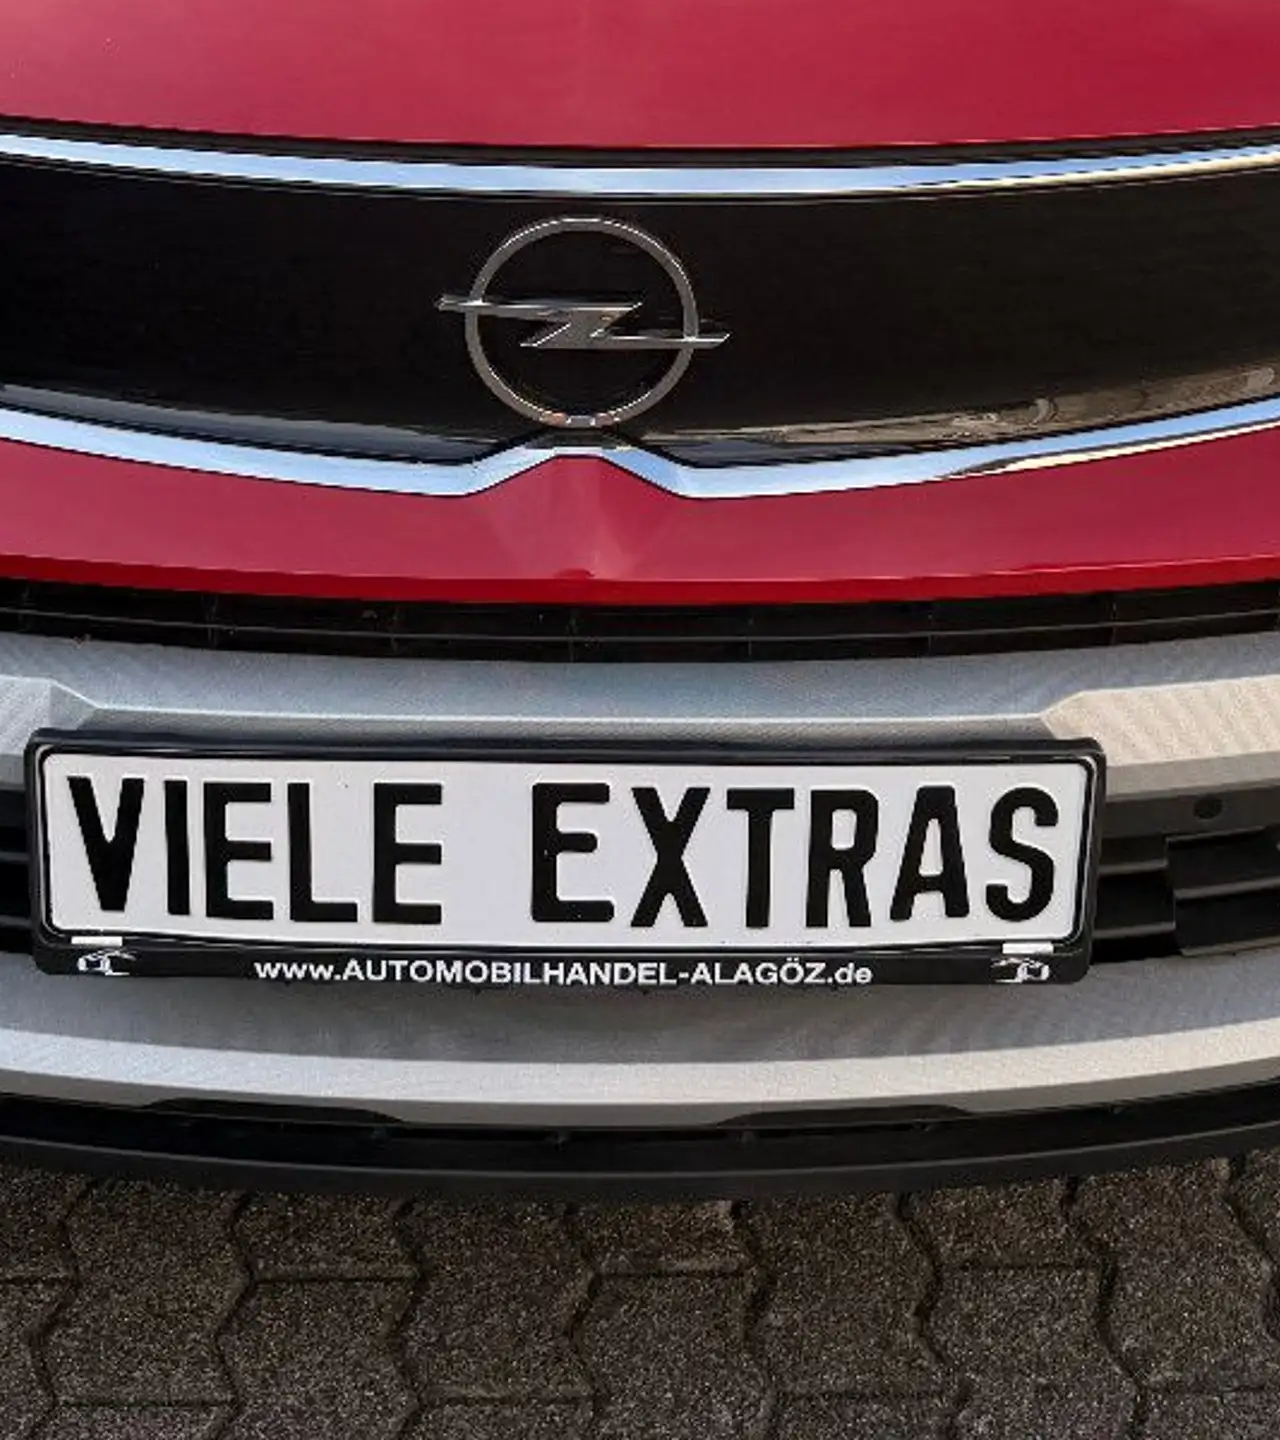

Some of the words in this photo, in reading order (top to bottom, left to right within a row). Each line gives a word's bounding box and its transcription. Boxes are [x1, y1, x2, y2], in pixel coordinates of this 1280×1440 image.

[67, 775, 443, 925] VIELE
[531, 782, 1059, 928] EXTRAS
[253, 956, 872, 985] www.AUTOMOBILHANDEL-ALAGÖZ.de
